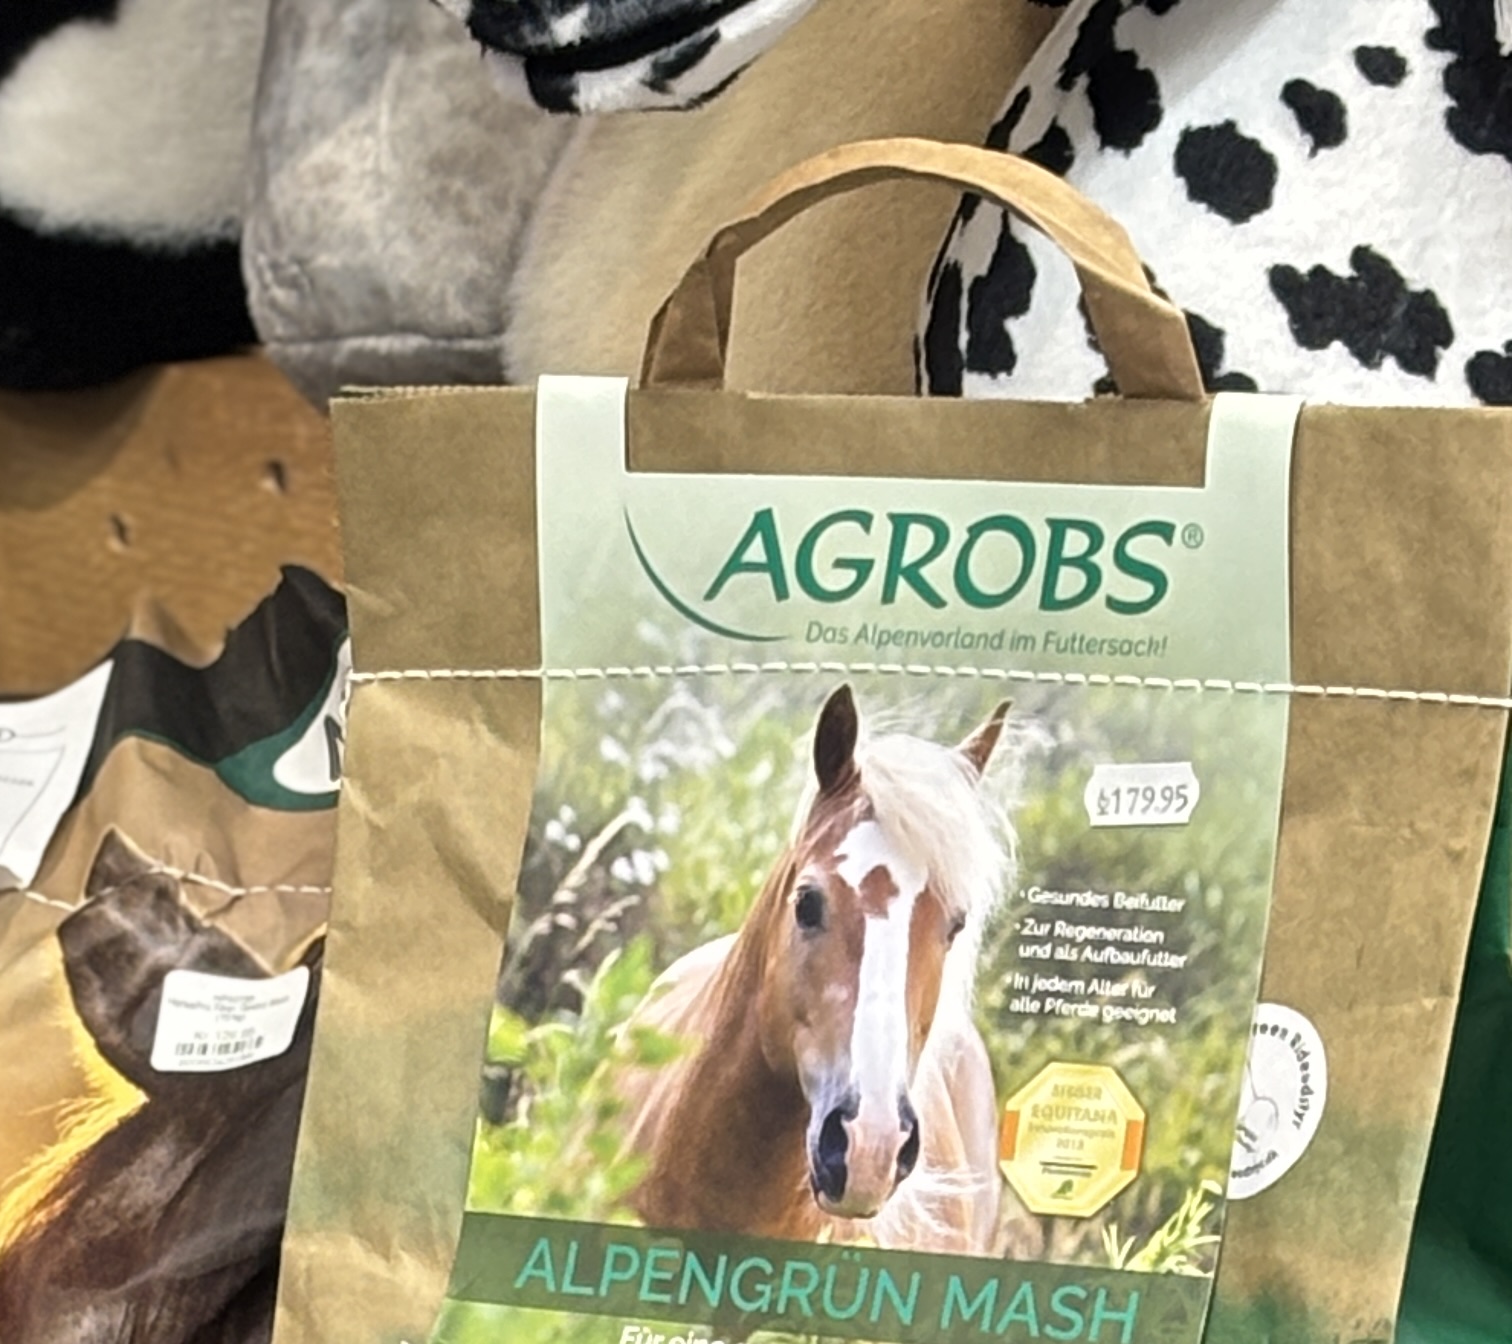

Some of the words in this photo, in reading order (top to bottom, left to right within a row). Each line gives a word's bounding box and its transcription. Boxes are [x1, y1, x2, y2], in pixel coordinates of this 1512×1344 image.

[804, 620, 849, 646] Das
[853, 624, 1005, 653] Alpenvorland
[1008, 630, 1038, 653] im
[1042, 630, 1169, 659] Futtersach!
[1027, 886, 1109, 910] Gesundes
[1113, 891, 1187, 913] Beifutter
[1020, 918, 1051, 937] Zur
[1053, 920, 1165, 944] Regeneration
[1018, 943, 1052, 960] und
[1054, 945, 1079, 961] als
[1081, 946, 1188, 969] Aufbaufutter
[1013, 972, 1029, 991] In
[1030, 974, 1086, 996] jedem
[1087, 977, 1130, 998] Alter
[1131, 981, 1157, 1000] für
[1009, 997, 1041, 1015] alle
[1043, 998, 1100, 1019] Pferde
[1101, 1004, 1178, 1027] geeignet
[1030, 1103, 1119, 1126] EQUITANA
[514, 1237, 922, 1327] ALPENGRÜN
